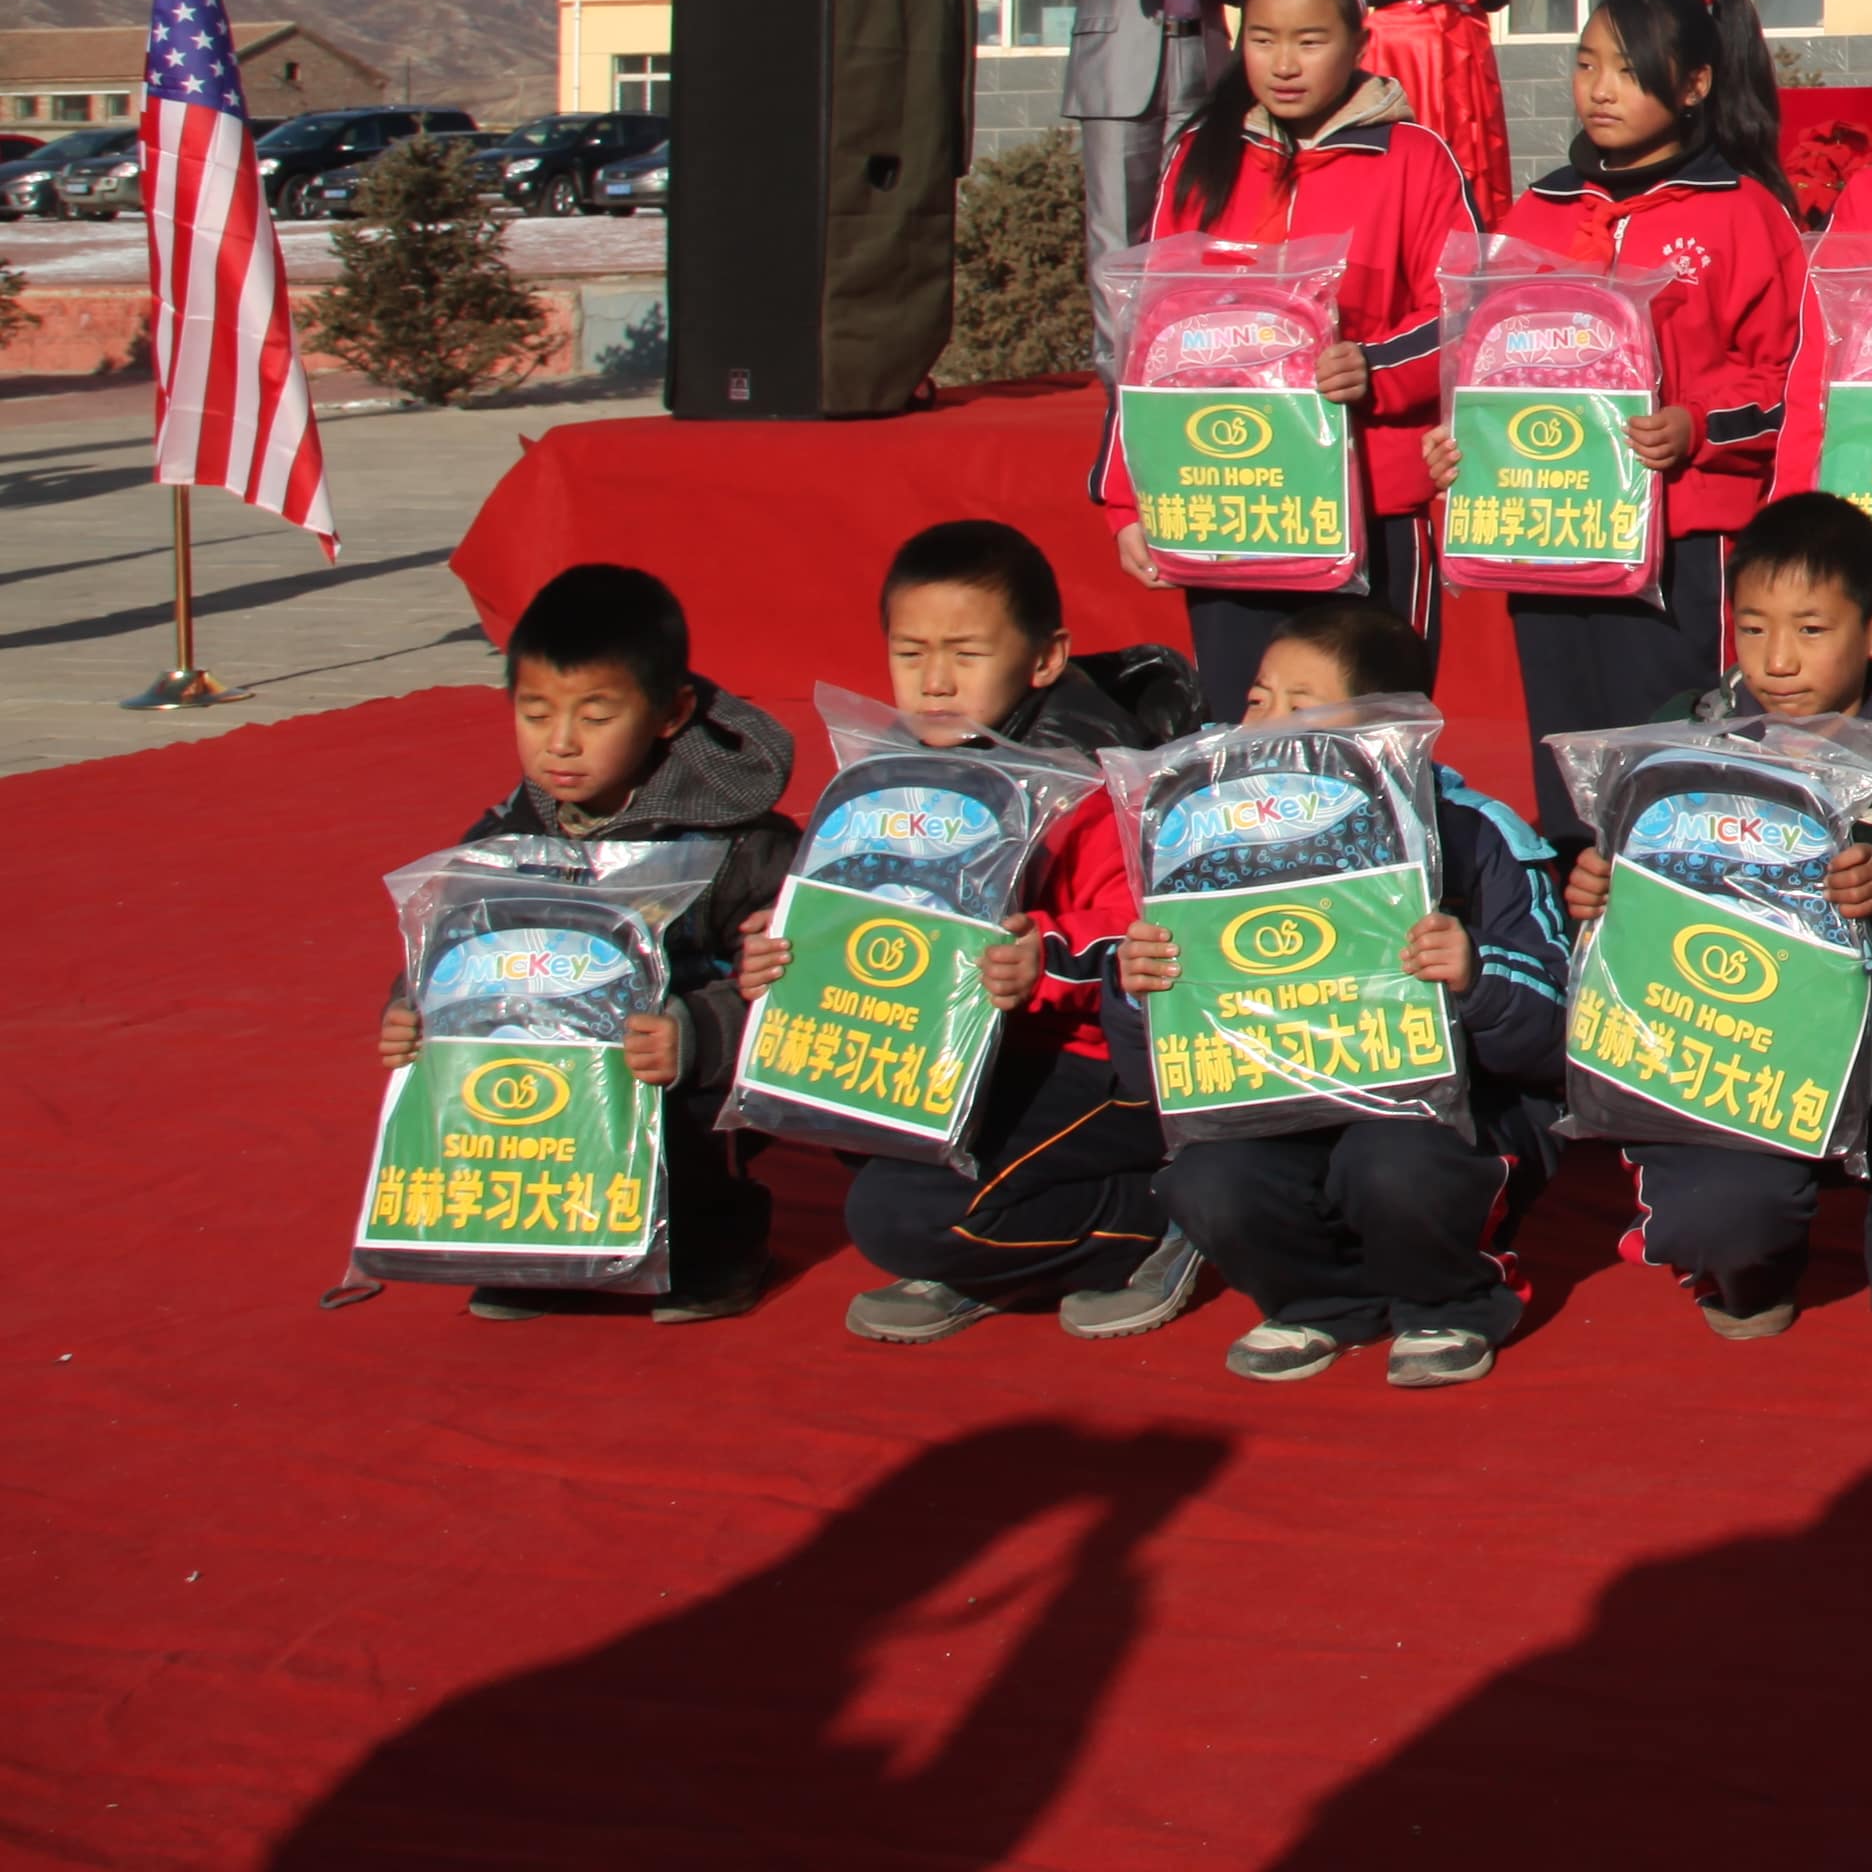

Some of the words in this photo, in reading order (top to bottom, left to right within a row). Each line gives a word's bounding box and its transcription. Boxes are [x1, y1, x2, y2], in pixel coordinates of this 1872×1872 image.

[1225, 467, 1285, 488] HOPE
[1537, 469, 1590, 490] HOPE
[1448, 495, 1640, 550] 尚赫学习大礼包
[861, 996, 921, 1030] HOPE
[1278, 976, 1360, 1011] HOPE
[1157, 1003, 1443, 1099] 尚赫学习大礼包
[1697, 1006, 1774, 1054] HOPE
[751, 1007, 966, 1115] 尚赫学习大礼包
[1568, 986, 1830, 1144] 尚赫学习大礼包
[500, 1134, 576, 1162] HOPE
[371, 1165, 643, 1234] 尚赫学习大礼包
